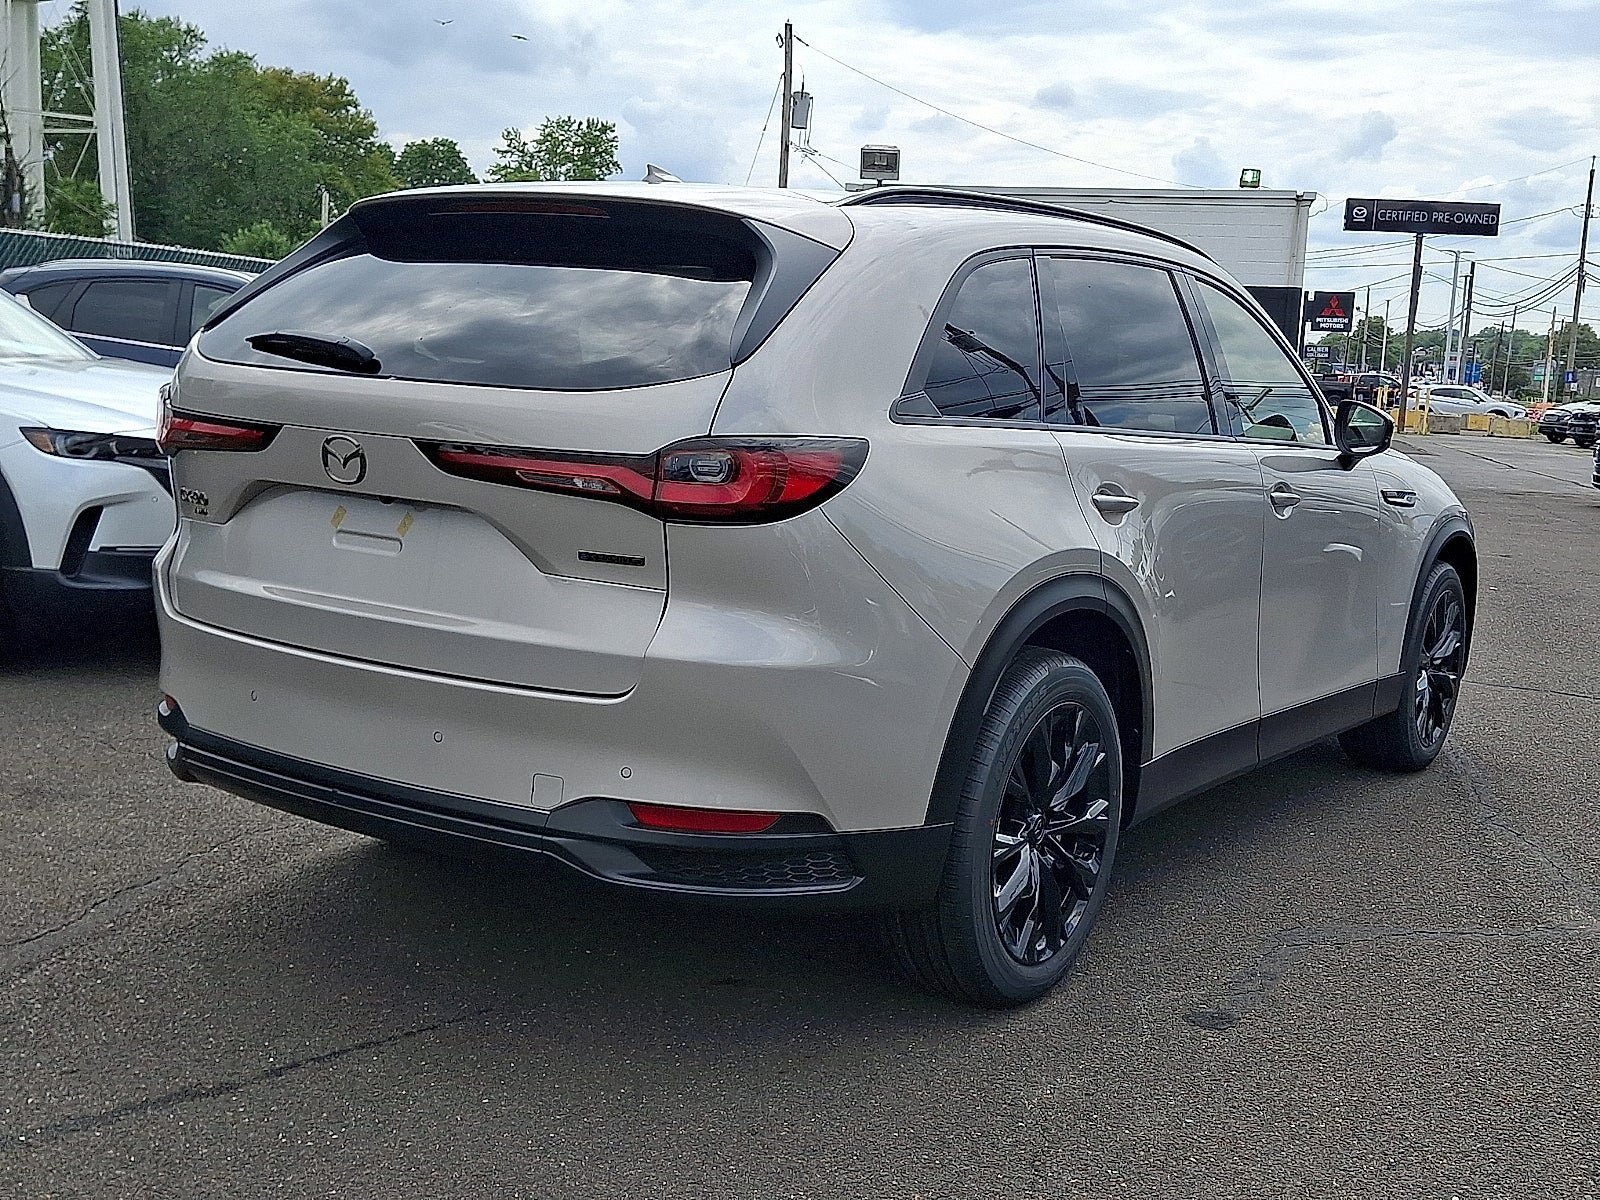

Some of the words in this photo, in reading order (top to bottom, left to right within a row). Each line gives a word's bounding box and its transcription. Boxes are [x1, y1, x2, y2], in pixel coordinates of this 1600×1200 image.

[1377, 209, 1428, 222] CERTIFIED
[1431, 211, 1498, 225] PRE-OWNED
[1315, 316, 1349, 324] MITSUBISHI
